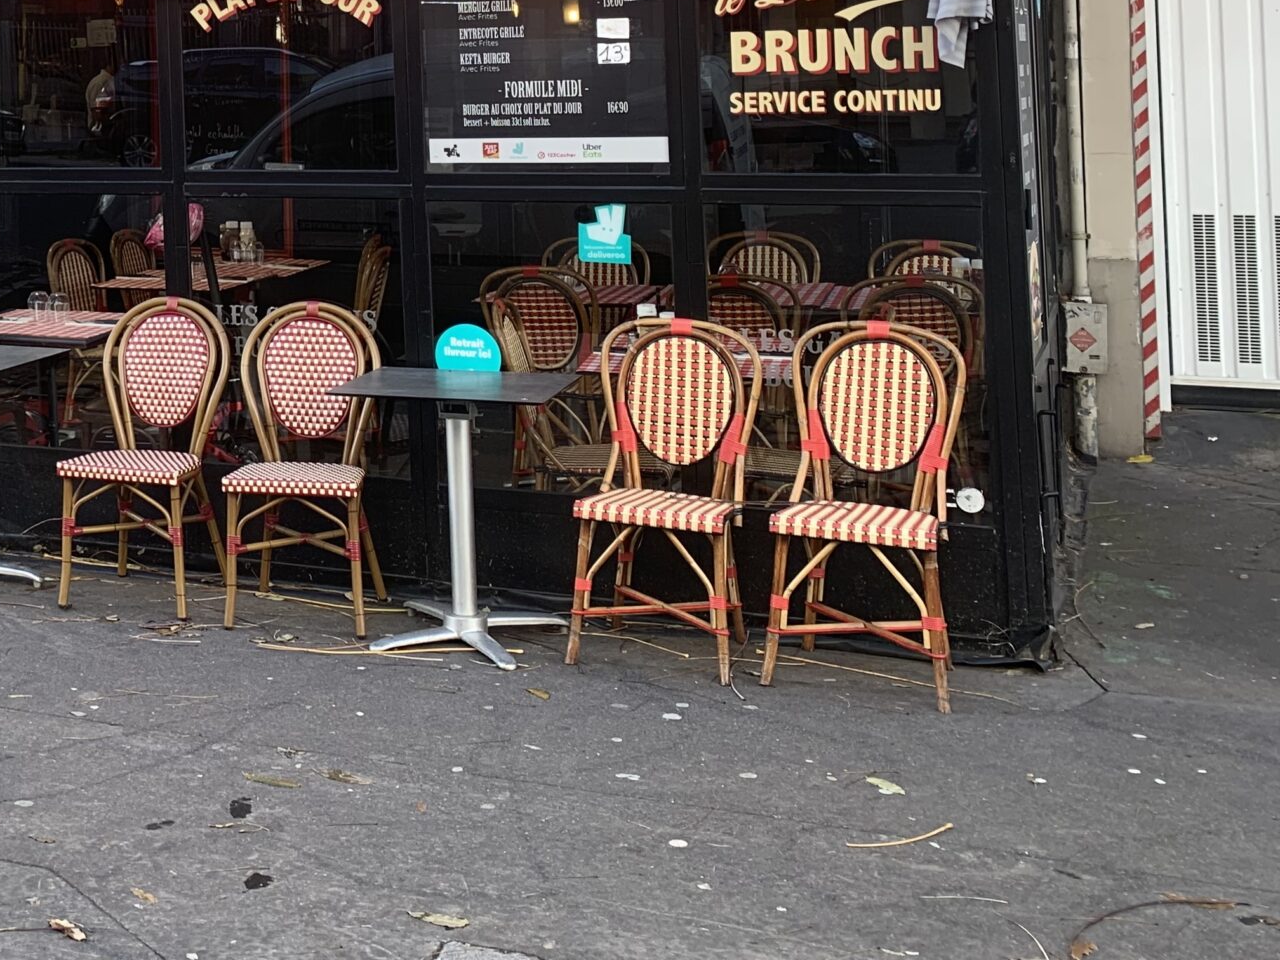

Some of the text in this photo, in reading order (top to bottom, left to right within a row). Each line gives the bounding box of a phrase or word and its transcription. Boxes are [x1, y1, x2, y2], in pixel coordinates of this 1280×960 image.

[458, 0, 490, 13] MERGUEZ
[478, 13, 498, 21] Frites
[459, 27, 499, 40] ENTRECOTE
[459, 39, 499, 48] Avec Frites
[730, 25, 939, 75] BRUNCH
[460, 52, 510, 65] KEFTA BURGER
[460, 64, 500, 73] Avec Frites
[504, 80, 554, 99] FORMULE
[730, 88, 942, 115] SERVICE CONTINU
[463, 102, 583, 116] BURGER AU CHOIX OU PLAT DU JOUR
[463, 117, 483, 127] Dessert
[582, 143, 602, 151] Uber
[582, 150, 602, 158] Eats
[215, 304, 259, 327] LES
[450, 336, 484, 348] Retrait
[443, 346, 492, 359] livreur ici
